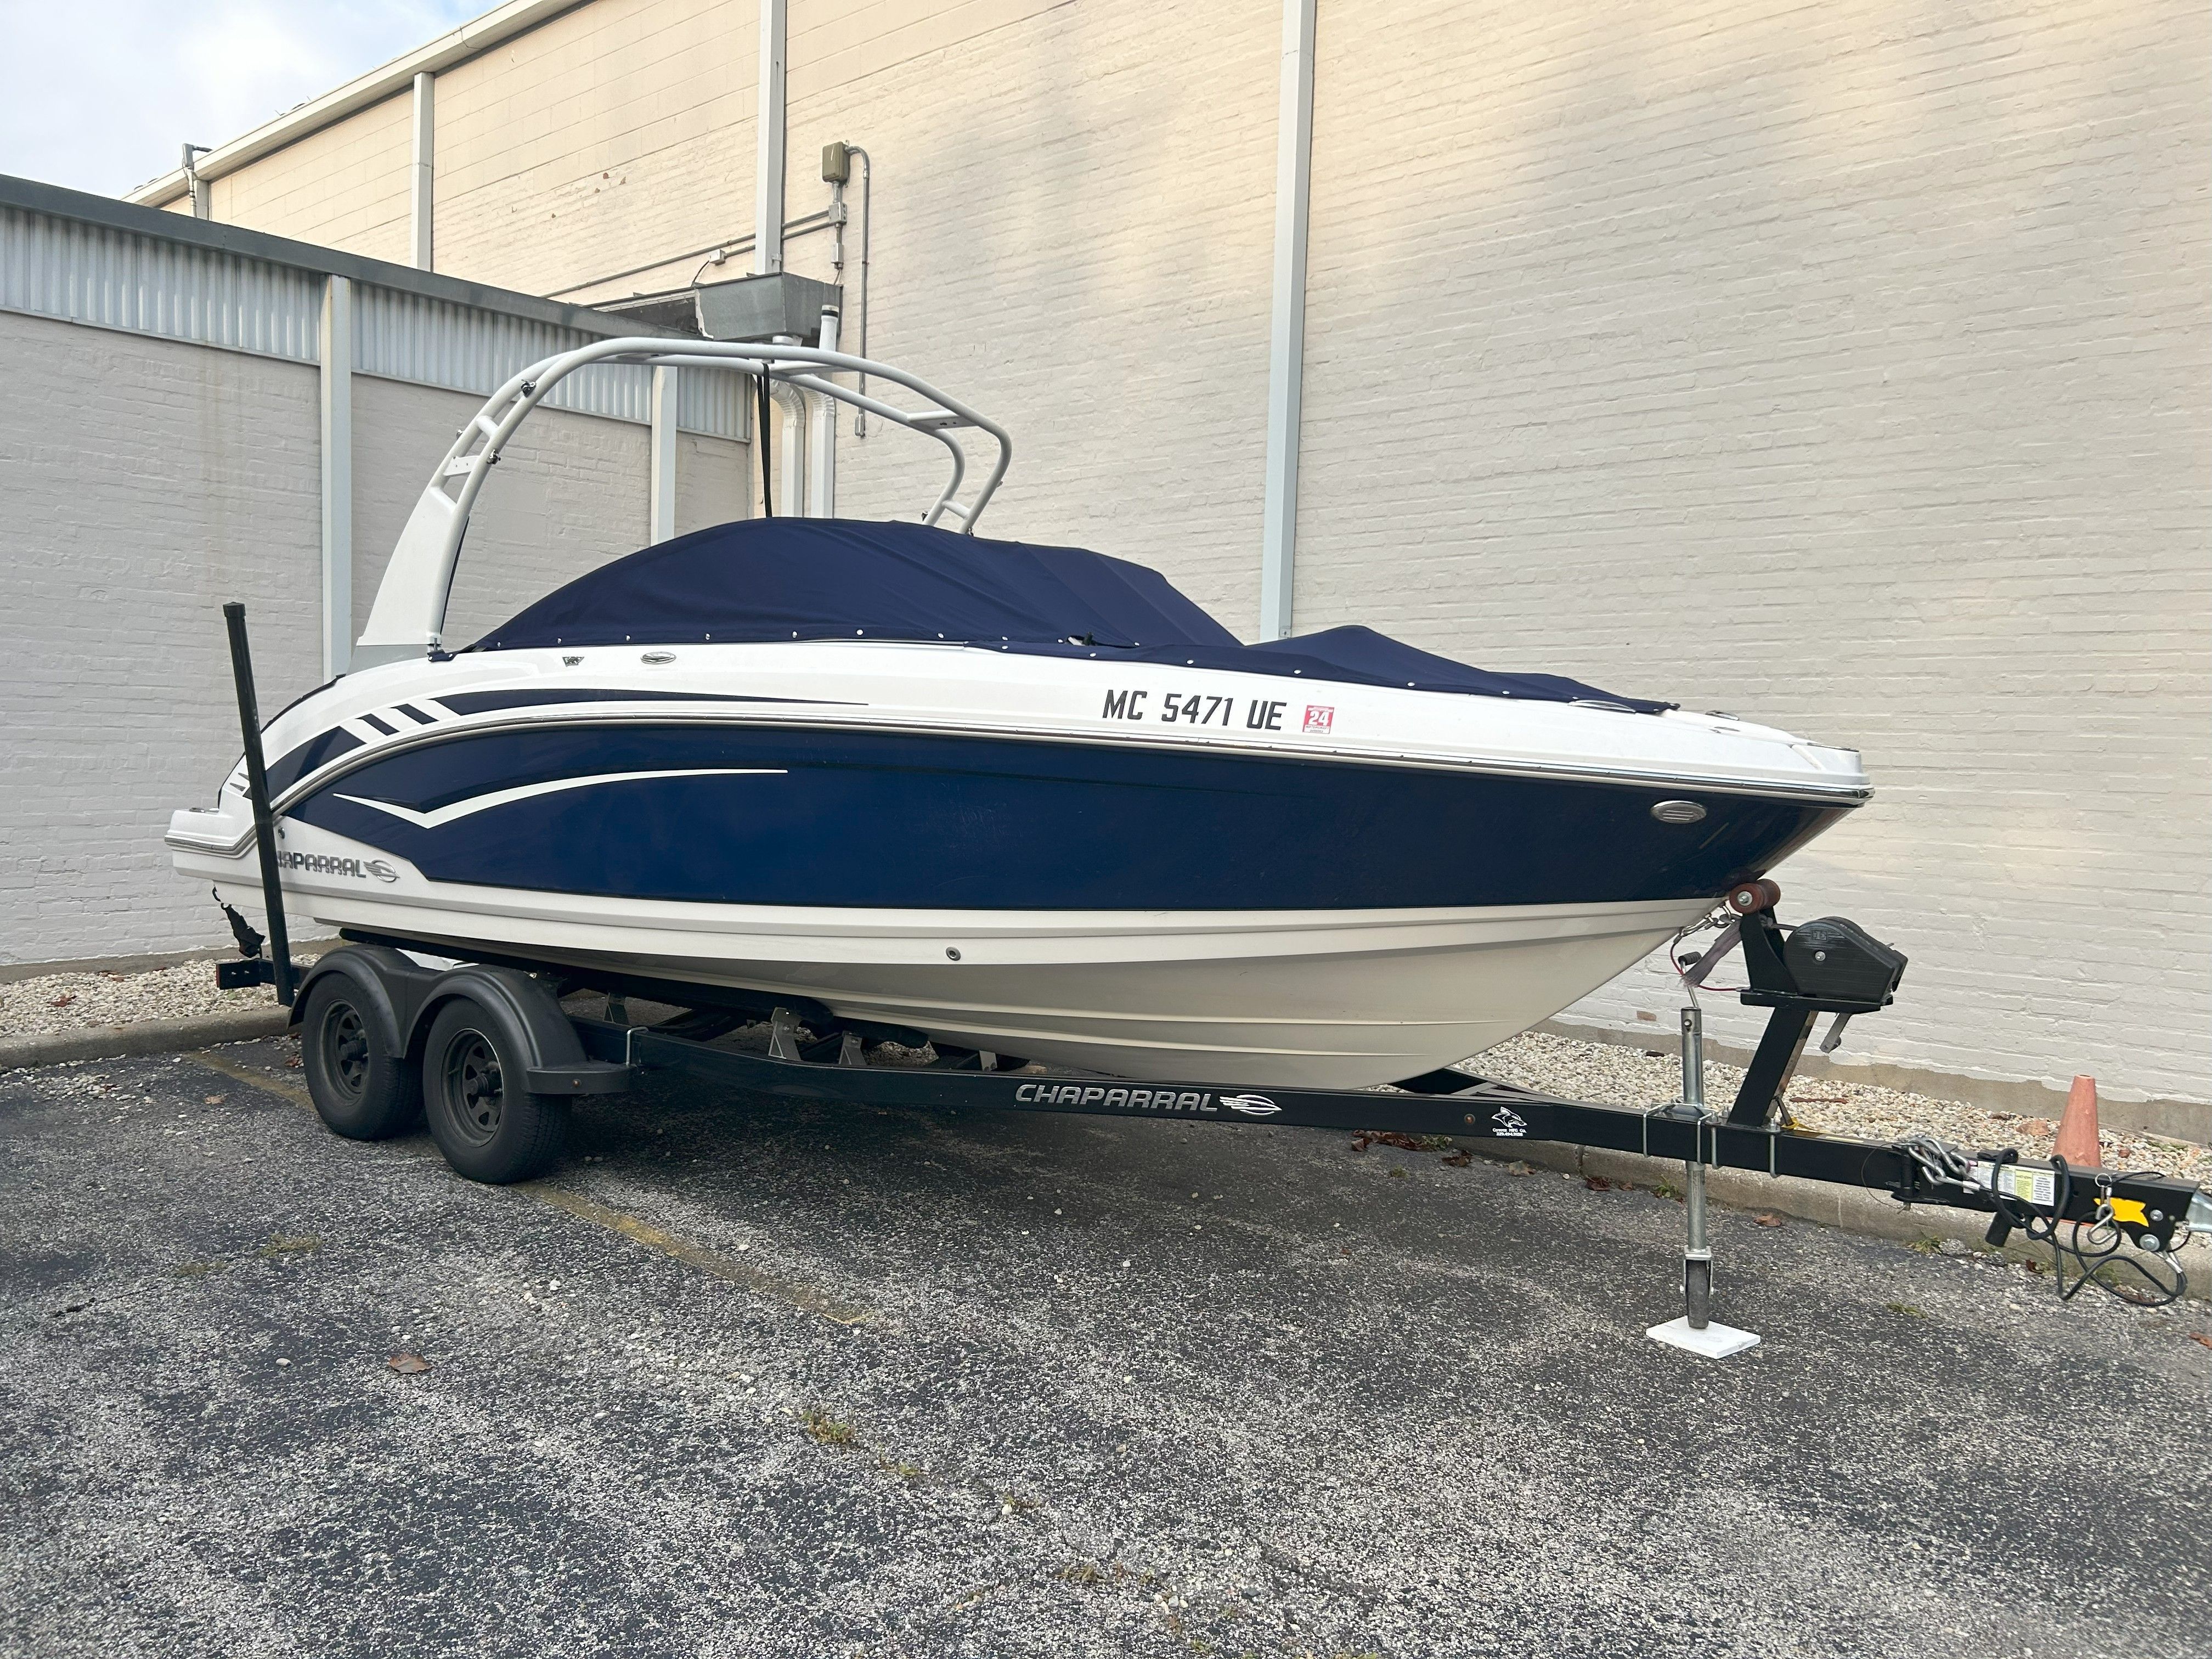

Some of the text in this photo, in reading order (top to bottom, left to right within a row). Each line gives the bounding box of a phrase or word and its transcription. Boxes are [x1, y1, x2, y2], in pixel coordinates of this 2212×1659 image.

[1102, 689, 1287, 731] MC 5471 UE
[1307, 710, 1330, 726] 24
[277, 850, 366, 878] APARRAL
[1015, 1084, 1218, 1111] CHAPARRAL
